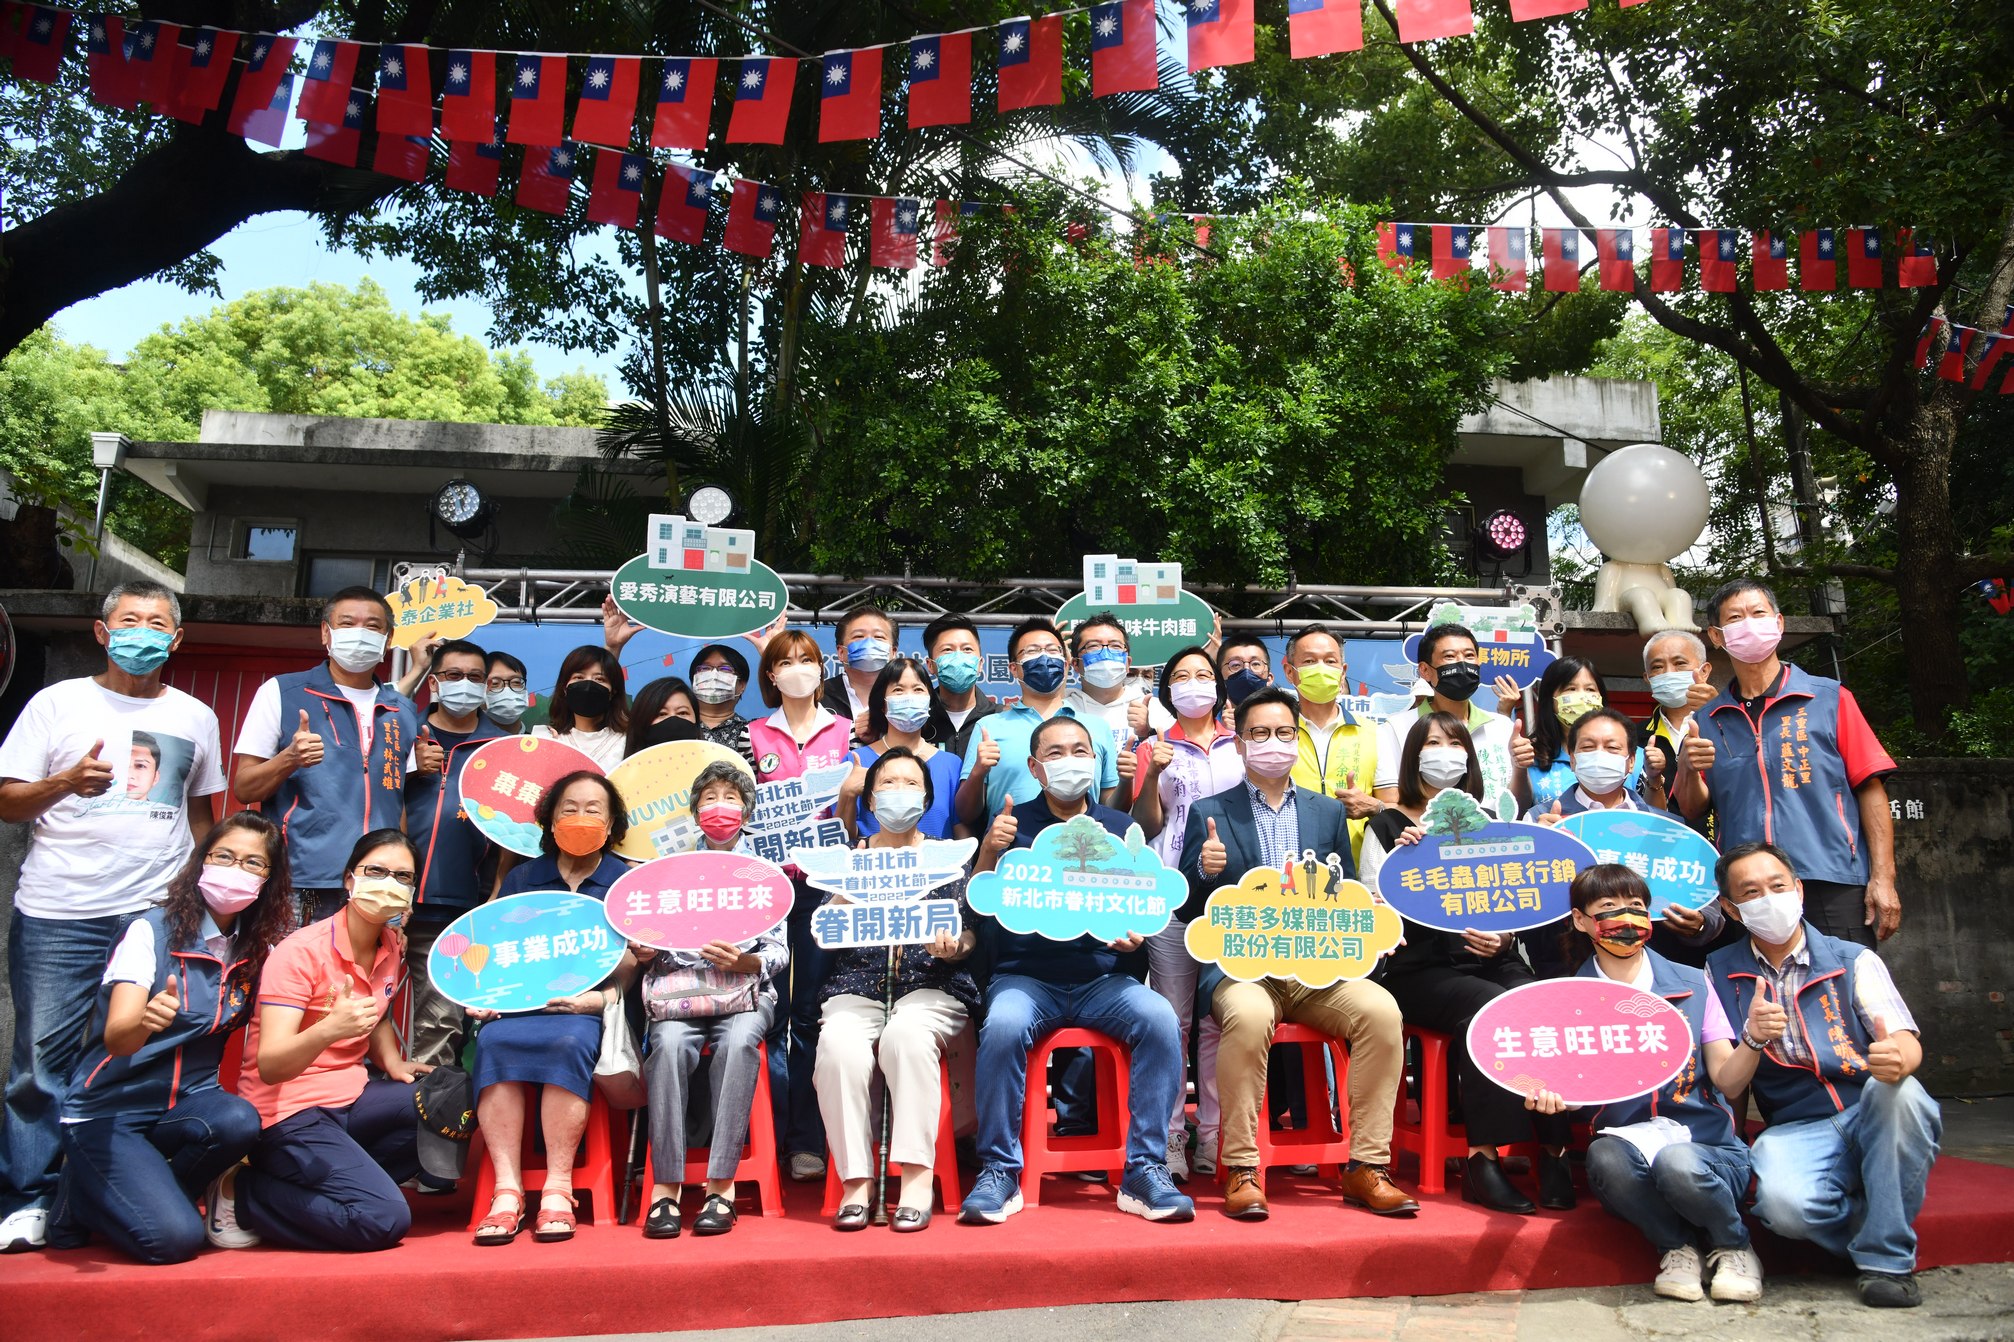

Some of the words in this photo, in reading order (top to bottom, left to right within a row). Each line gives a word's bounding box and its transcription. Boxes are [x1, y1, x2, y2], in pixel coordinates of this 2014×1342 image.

[619, 582, 776, 610] 愛秀演藝有限公司
[393, 600, 474, 628] 泰企業社
[852, 851, 917, 872] 新北市
[1002, 863, 1053, 883] 2022
[1400, 858, 1577, 892] 毛毛蟲創意行銷
[845, 873, 928, 891] 眷村文化節
[625, 884, 773, 916] 生意旺旺來
[869, 892, 904, 902] 2022
[1002, 886, 1167, 917] 新北市眷村文化節
[1440, 887, 1542, 916] 有限公司
[815, 904, 958, 944] 眷開新局
[1211, 905, 1375, 934] 時藝多媒體傳播
[492, 925, 608, 968] 事業成功
[1223, 933, 1363, 961] 股份有限公司
[1493, 1021, 1669, 1059] 生意旺旺來
